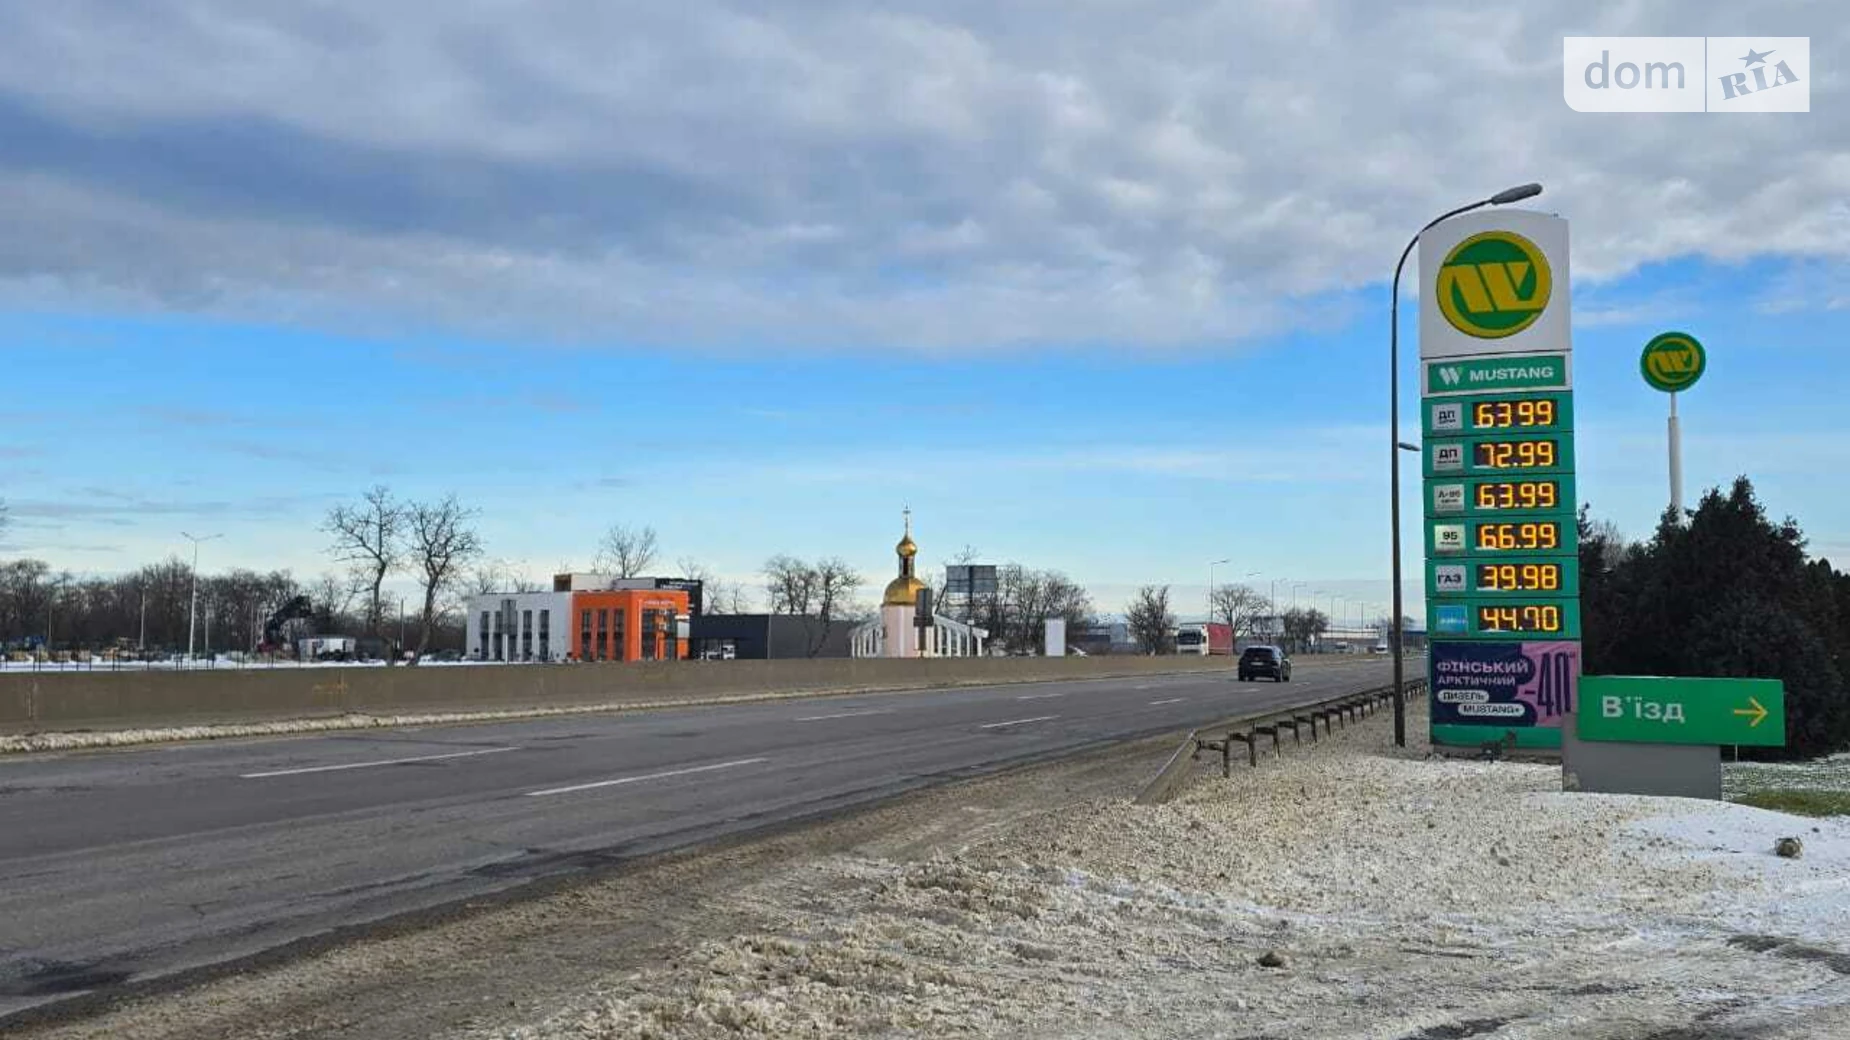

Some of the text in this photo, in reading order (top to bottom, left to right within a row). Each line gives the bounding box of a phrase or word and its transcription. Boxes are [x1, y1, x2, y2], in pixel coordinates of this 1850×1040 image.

[1469, 366, 1554, 382] MUSTANG
[1439, 442, 1553, 467] ДП 72.99
[1479, 483, 1554, 508] 63.99
[1443, 524, 1556, 549] 95 66.99
[1438, 565, 1557, 590] ГАЗ 39.98
[1483, 606, 1558, 631] 44.70
[1437, 660, 1528, 673] ФІНСЬКИЙ
[1437, 675, 1516, 685] АРКТИЧНИЙ
[1602, 695, 1685, 724] В'їзд
